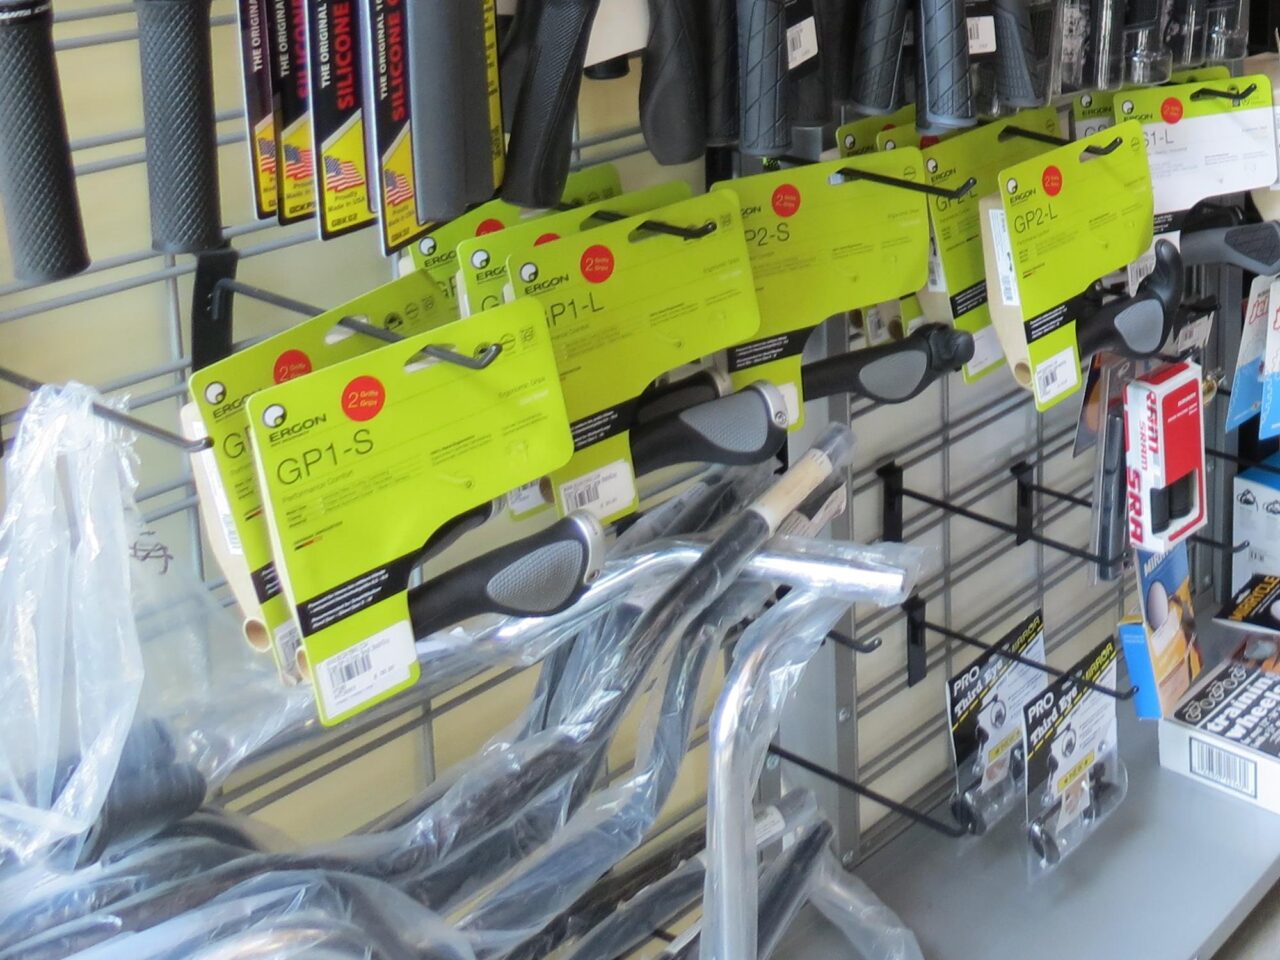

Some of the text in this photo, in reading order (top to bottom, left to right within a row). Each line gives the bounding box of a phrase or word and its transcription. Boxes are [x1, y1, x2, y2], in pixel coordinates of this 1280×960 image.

[316, 1, 331, 63] ORIGINAL
[376, 12, 388, 72] ORIGINAL
[252, 52, 264, 73] THE
[279, 56, 291, 78] THE
[331, 1, 355, 111] SILICONE
[387, 11, 406, 122] SILICONE
[320, 64, 332, 89] THE
[380, 72, 389, 100] THE
[1013, 204, 1058, 235] GP2-L
[585, 257, 593, 272] 2
[524, 273, 570, 295] ERGON
[546, 291, 605, 329] P1-L
[347, 392, 359, 409] 2
[268, 413, 328, 443] ERGON
[276, 428, 375, 486] GP1-S
[1138, 420, 1148, 472] SRAM
[1126, 465, 1144, 544] SRA
[953, 664, 980, 697] PRO
[954, 681, 984, 717] Third
[1027, 691, 1055, 724] PRO
[1029, 685, 1079, 745] Third Eye
